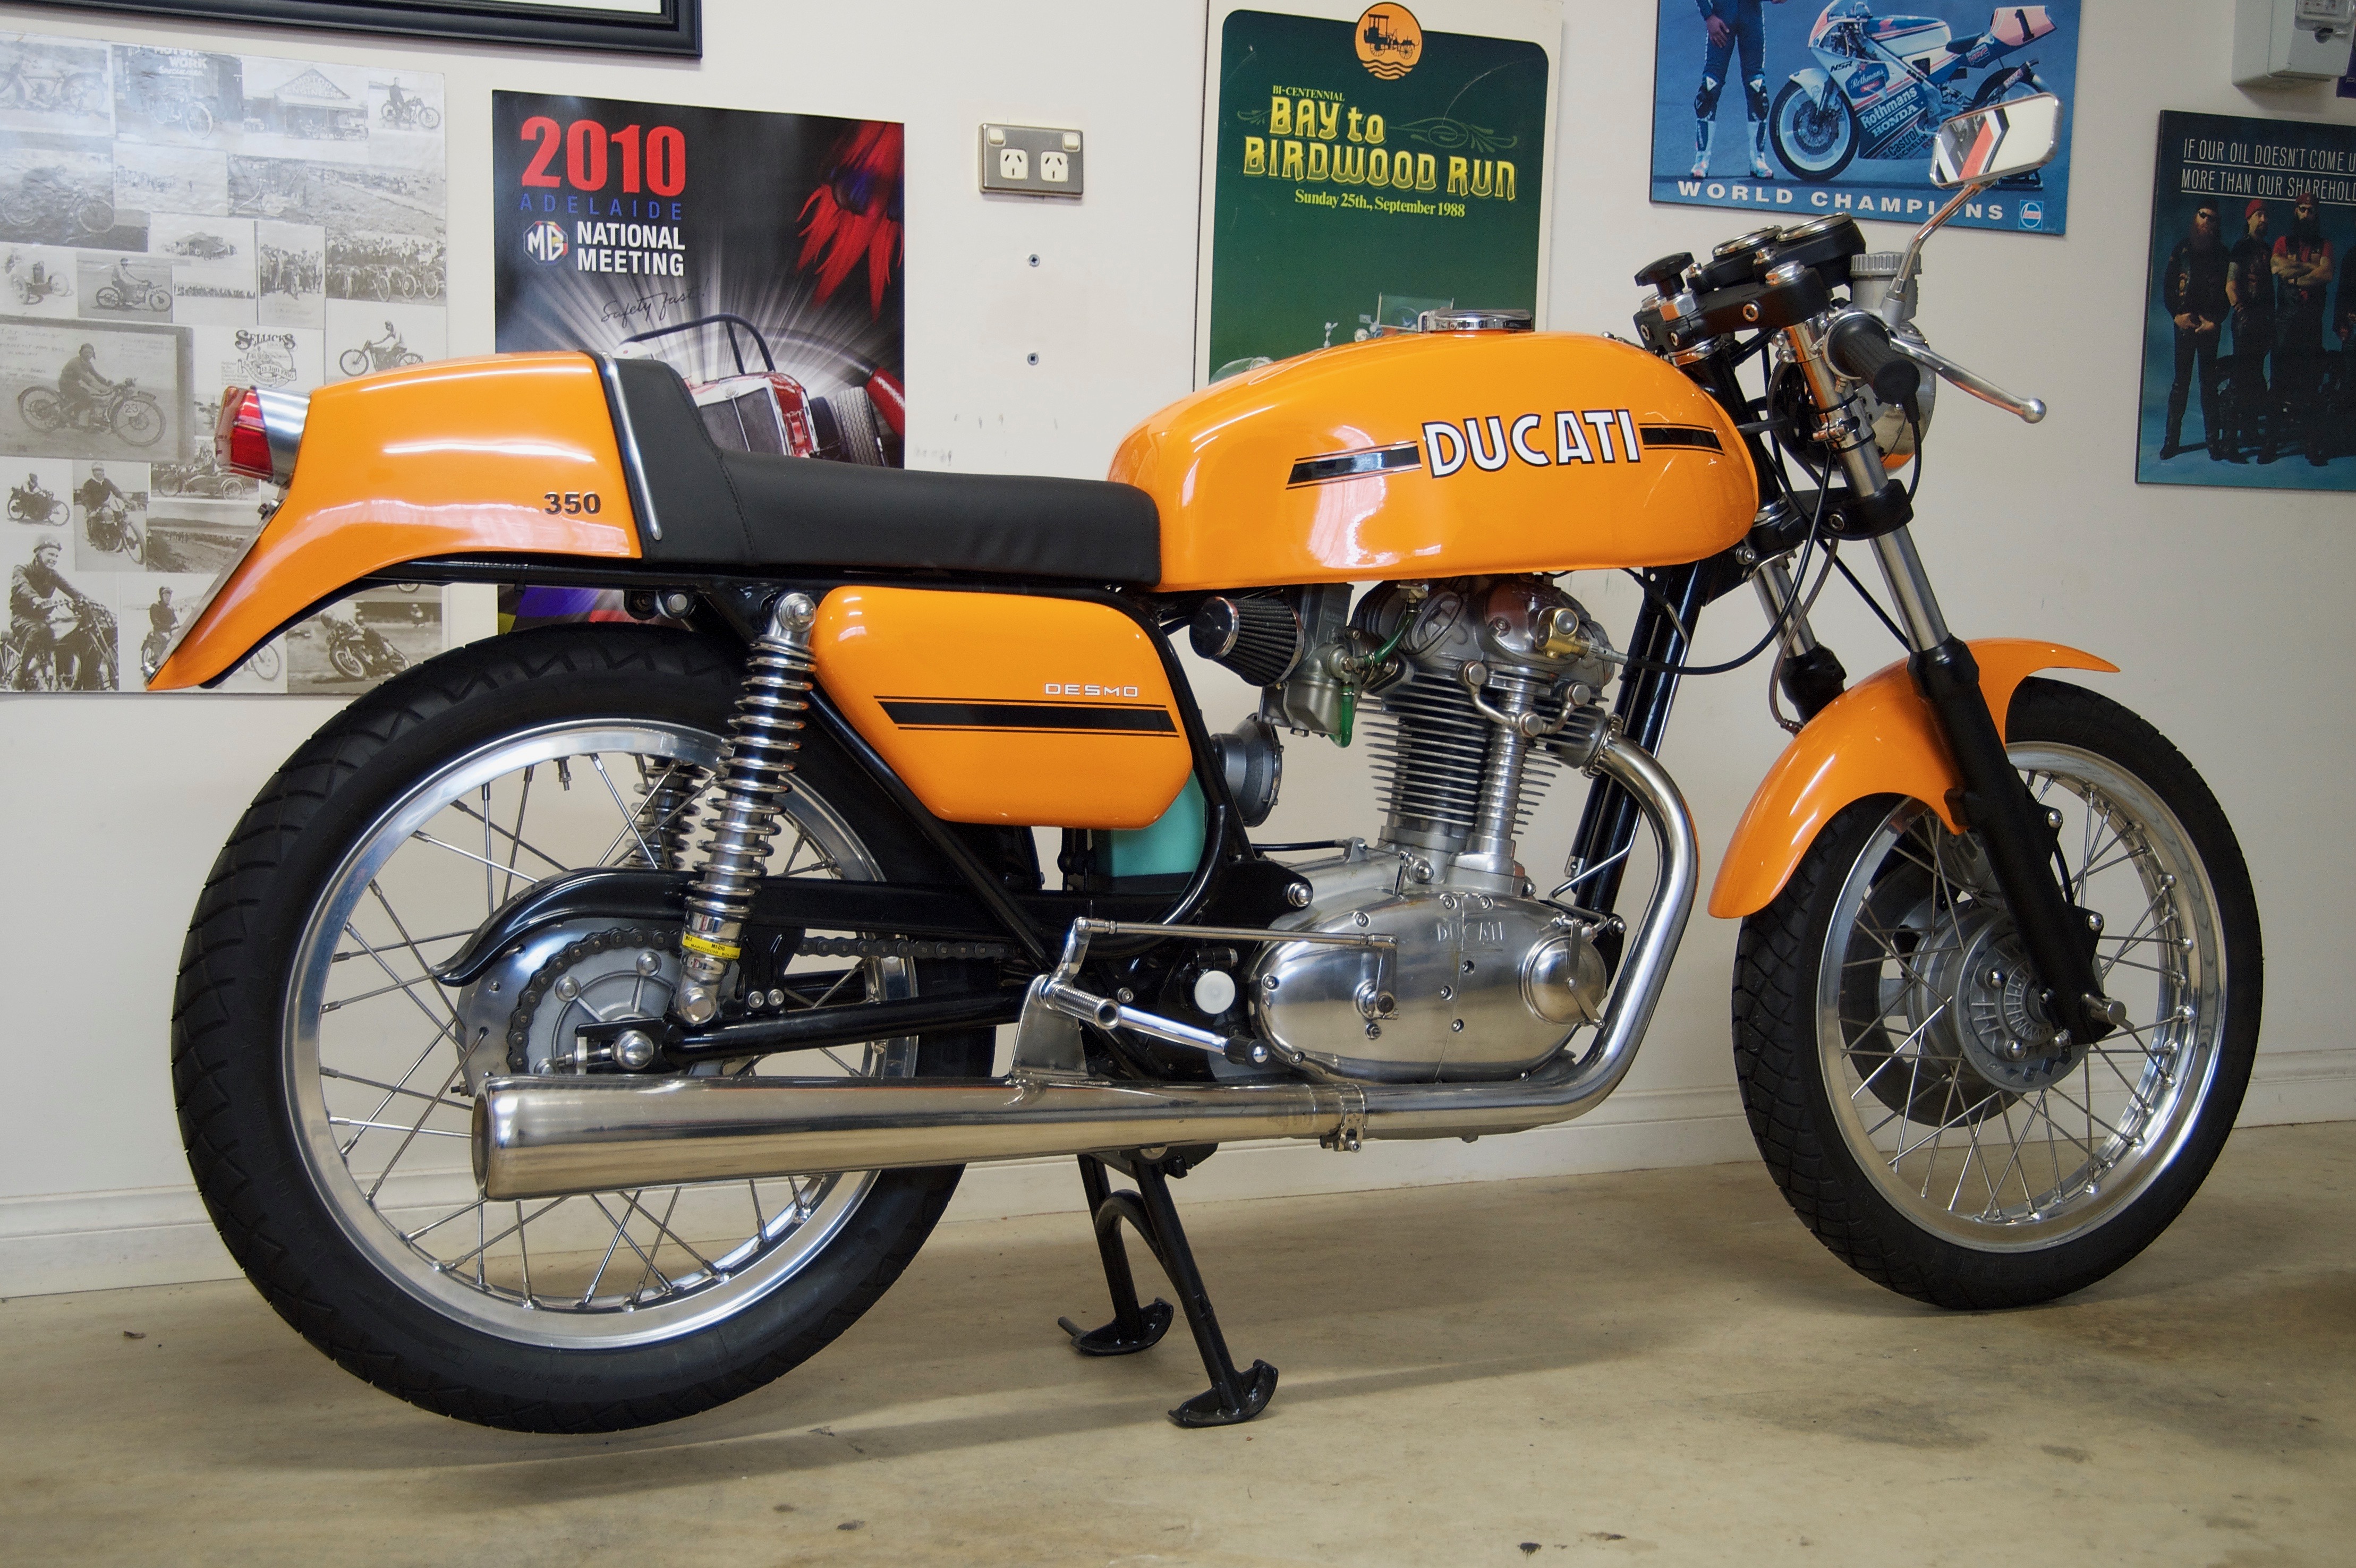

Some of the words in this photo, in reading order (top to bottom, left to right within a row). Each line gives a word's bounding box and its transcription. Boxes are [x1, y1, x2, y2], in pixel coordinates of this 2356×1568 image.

[2014, 8, 2035, 42] 1
[169, 56, 208, 69] WORK
[1830, 61, 1853, 72] NSR
[1272, 85, 1345, 102] BI-CENTENNIAL
[1851, 69, 1884, 89] Rothmans
[1270, 95, 1343, 141] BAY
[1347, 106, 1386, 145] to
[1860, 87, 1918, 129] Rothmans
[1871, 105, 1918, 138] HONDA
[520, 115, 686, 197] 2010
[1887, 126, 1920, 156] Castrol
[2183, 138, 2196, 158] IF
[2199, 139, 2224, 161] OUR
[2230, 142, 2249, 164] OIL
[2255, 144, 2306, 167] DOESN'T
[2309, 149, 2344, 172] COME
[1243, 136, 1438, 192] BIRDWOOD
[1447, 156, 1517, 201] RUN
[2181, 168, 2216, 191] MORE
[2220, 172, 2251, 193] THAN
[2258, 175, 2283, 196] OUR
[520, 193, 683, 220] ADELAIDE
[1295, 189, 1339, 209] Sunday
[1374, 197, 1436, 217] September
[1438, 202, 1466, 218] 1988
[1678, 181, 1793, 204] WORLD
[526, 226, 565, 261] MG
[577, 221, 686, 251] NATIONAL
[577, 247, 685, 277] MEETING
[599, 297, 653, 331] Safety
[235, 329, 296, 350] SELLICKS
[124, 404, 138, 413] 23
[1422, 408, 1640, 479] DUCATI
[544, 492, 601, 515] 350
[1045, 683, 1139, 698] DESMO
